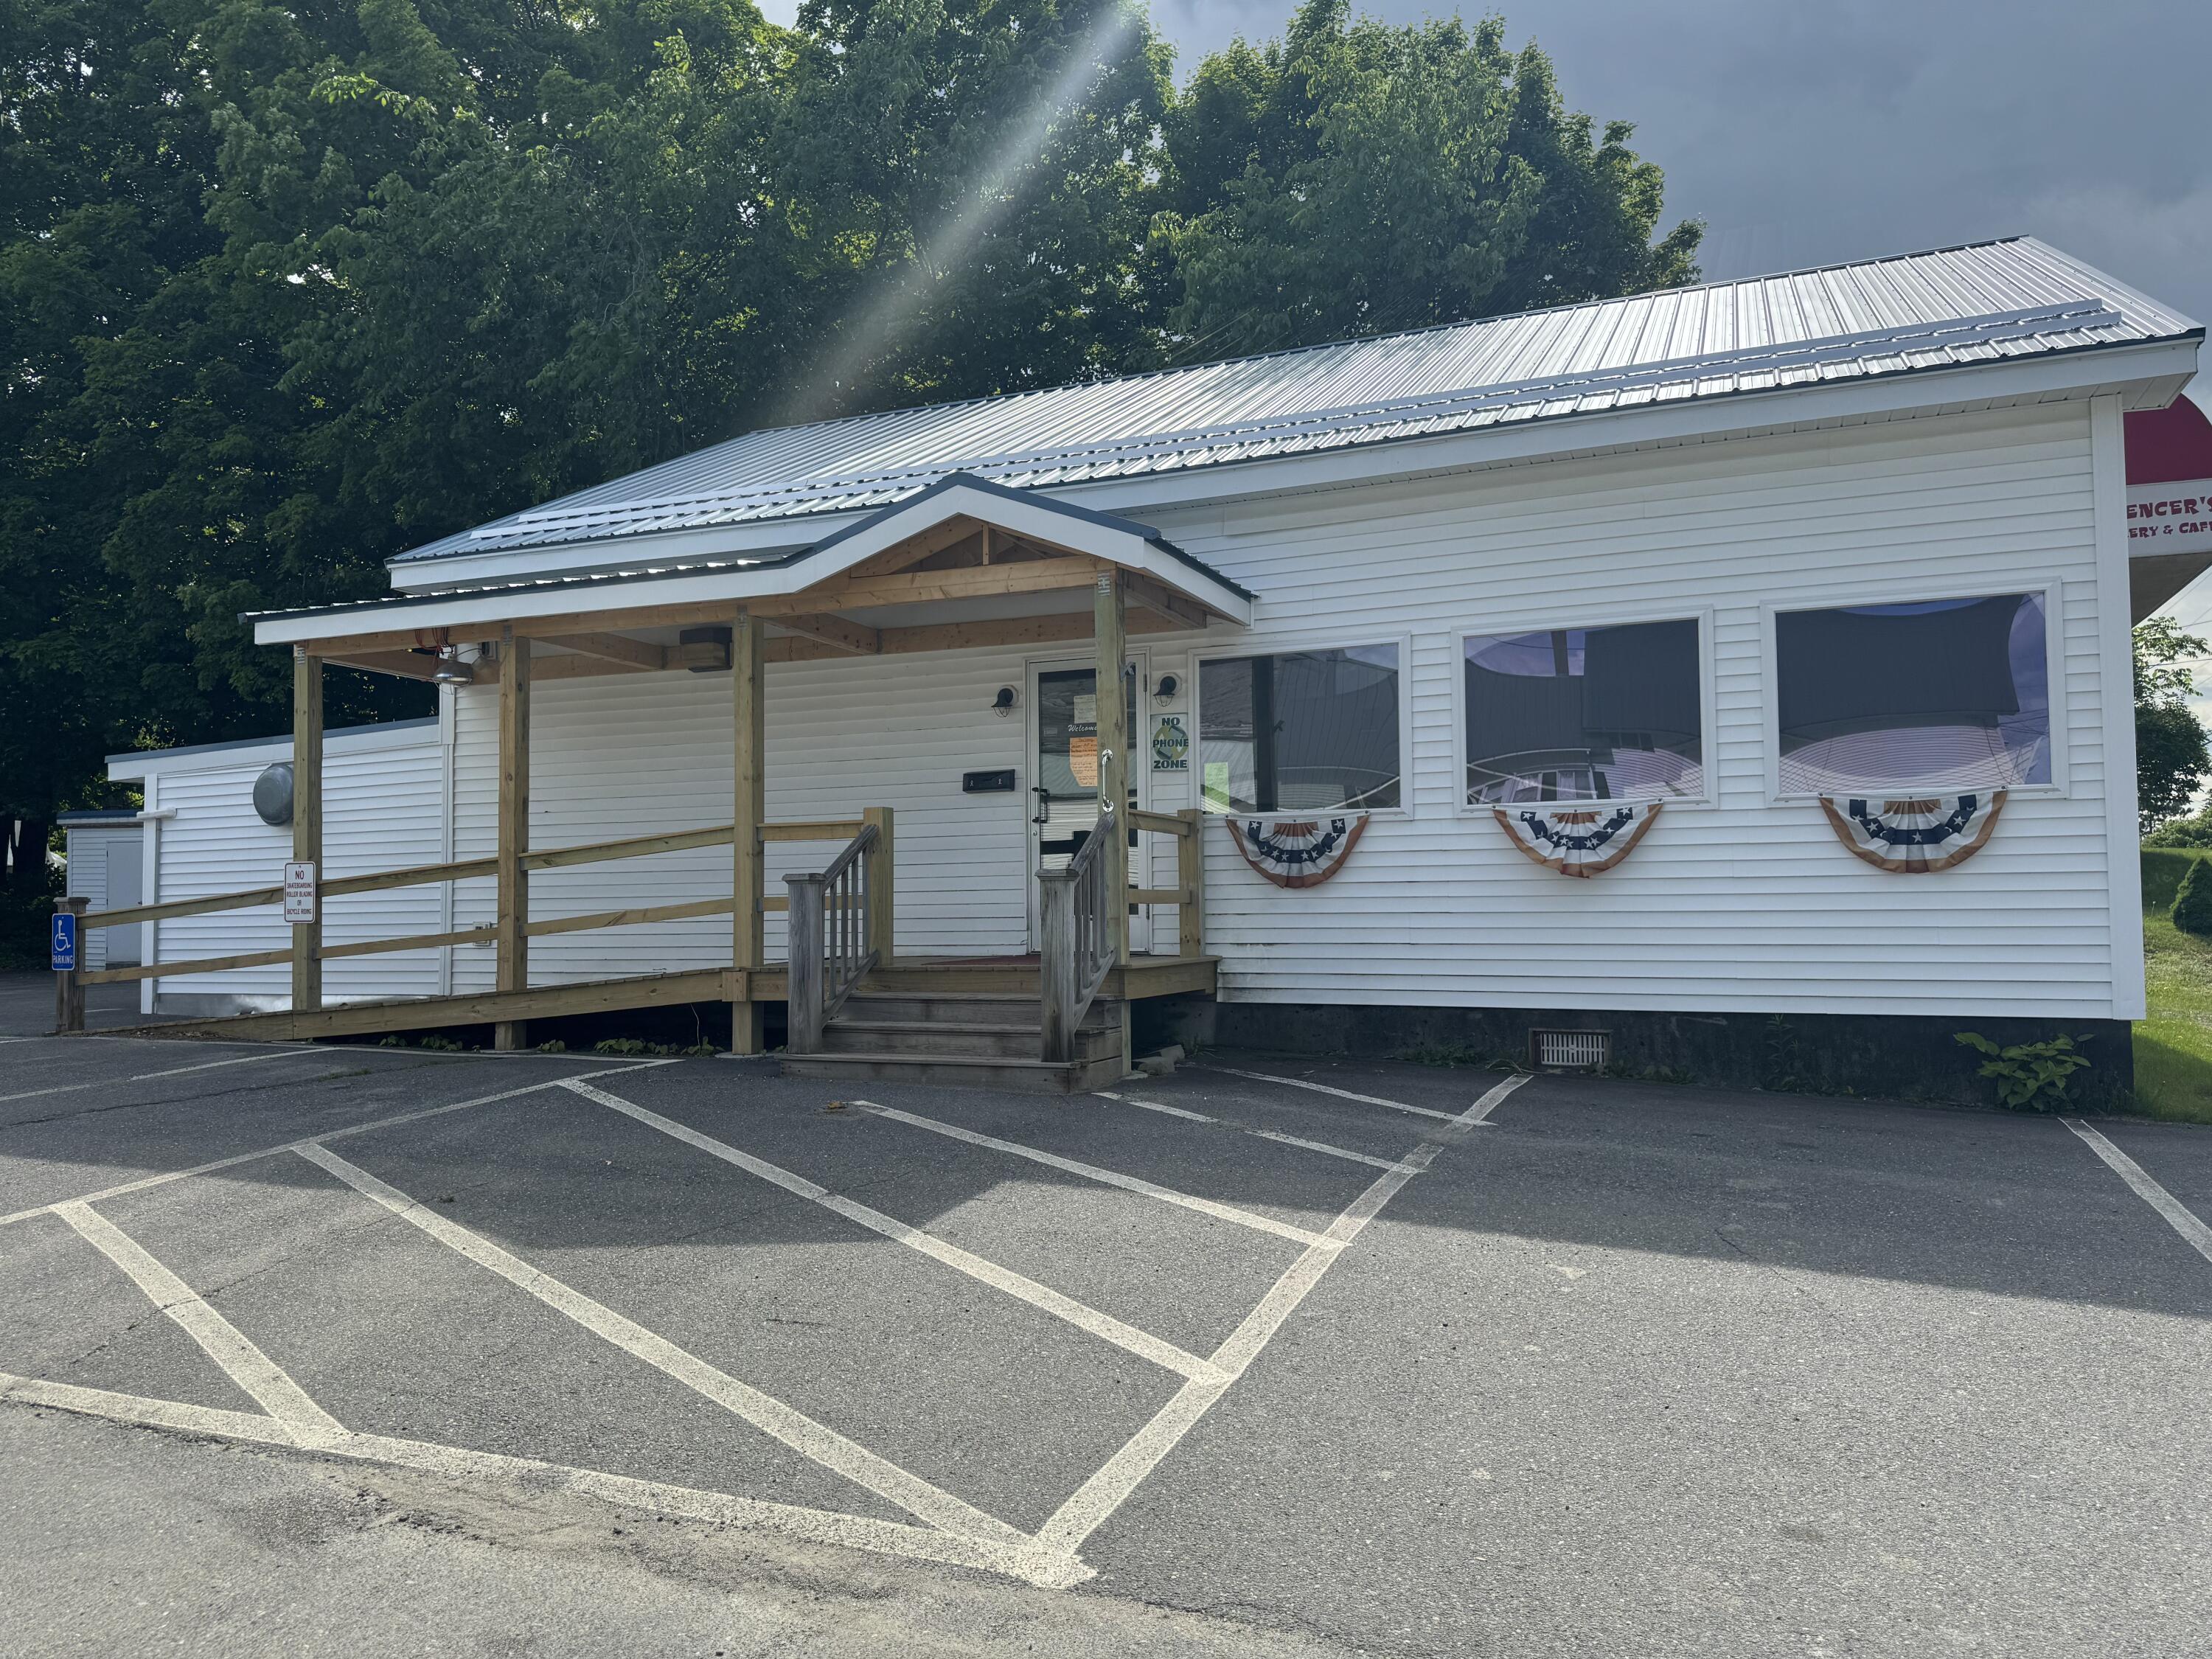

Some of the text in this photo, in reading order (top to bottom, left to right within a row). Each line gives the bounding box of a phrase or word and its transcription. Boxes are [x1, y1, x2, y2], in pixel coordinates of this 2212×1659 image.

[2127, 526, 2158, 538] ERY
[2163, 525, 2174, 535] &
[1162, 717, 1180, 726] NO
[1152, 739, 1189, 748] PHONE
[1153, 759, 1187, 769] ZONE
[295, 870, 305, 880] NO
[53, 955, 73, 964] PARKING
